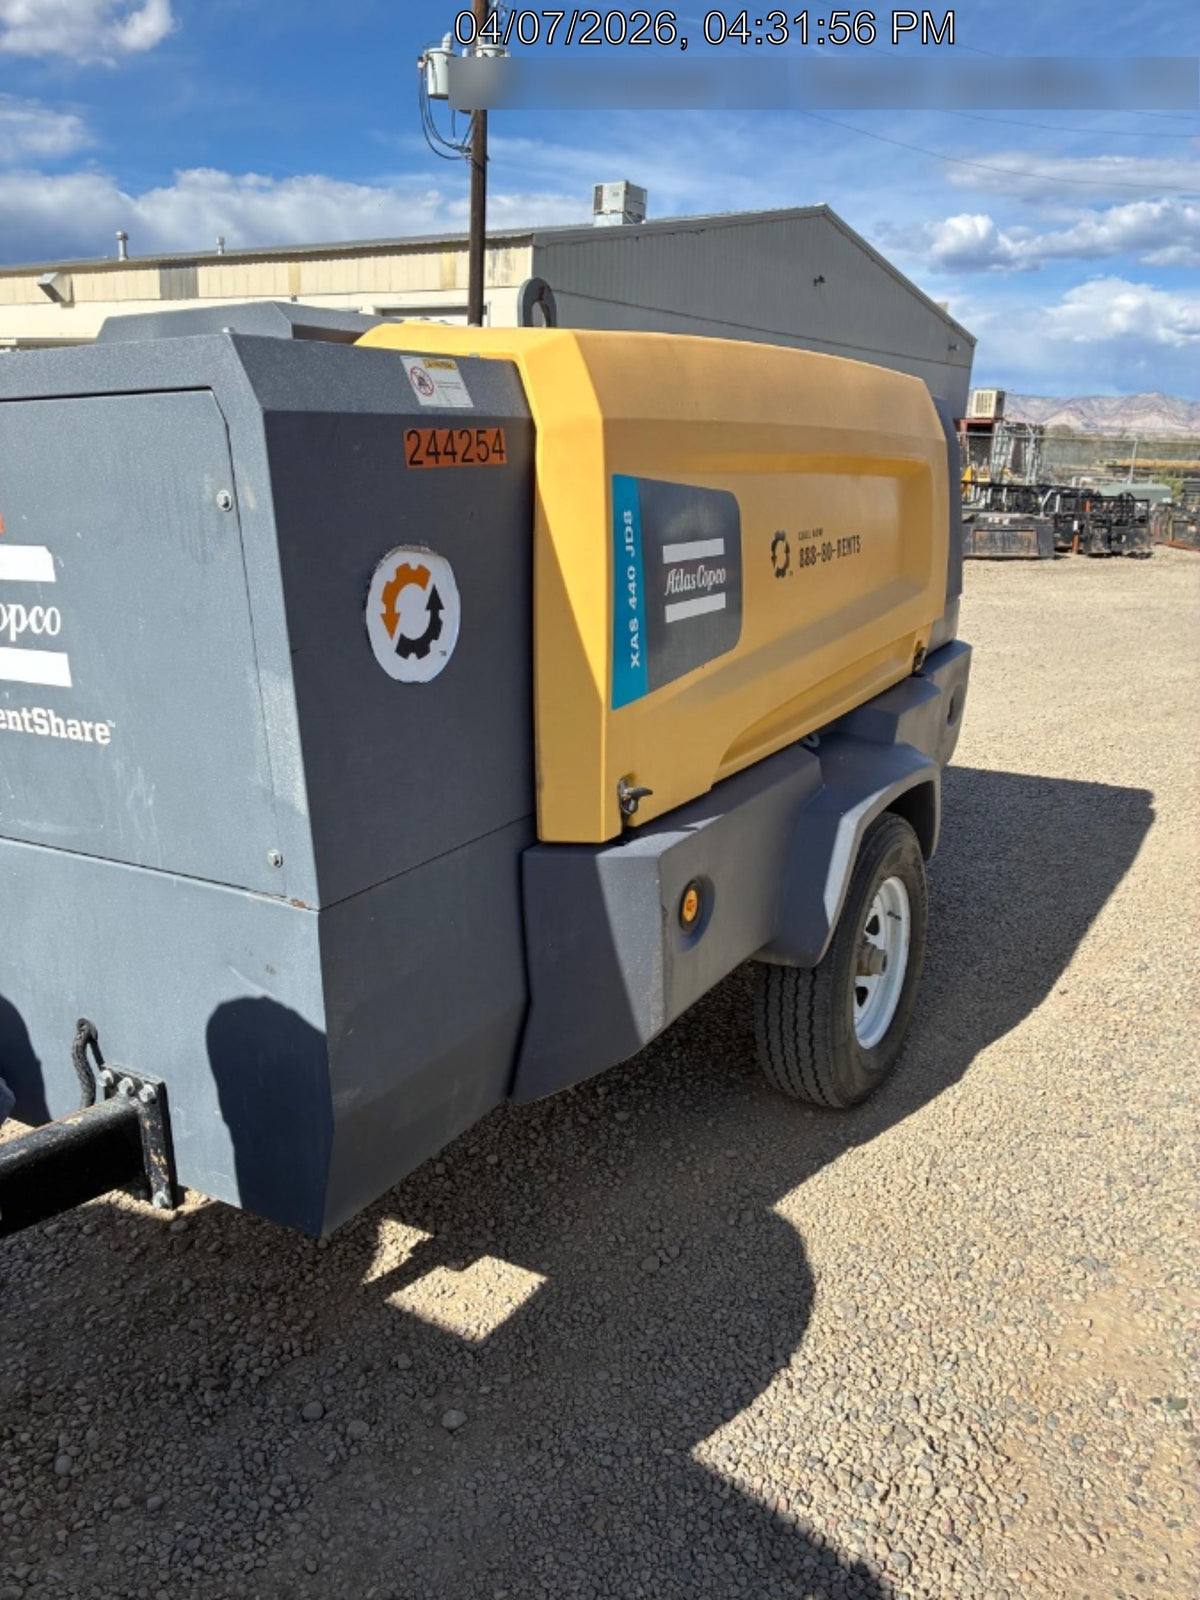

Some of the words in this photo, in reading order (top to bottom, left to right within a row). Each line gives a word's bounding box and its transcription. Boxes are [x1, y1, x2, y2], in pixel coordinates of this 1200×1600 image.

[407, 429, 505, 466] 244254
[626, 565, 638, 610] 440
[664, 568, 696, 596] Atlas
[696, 564, 727, 592] Copco
[629, 617, 641, 669] XAS
